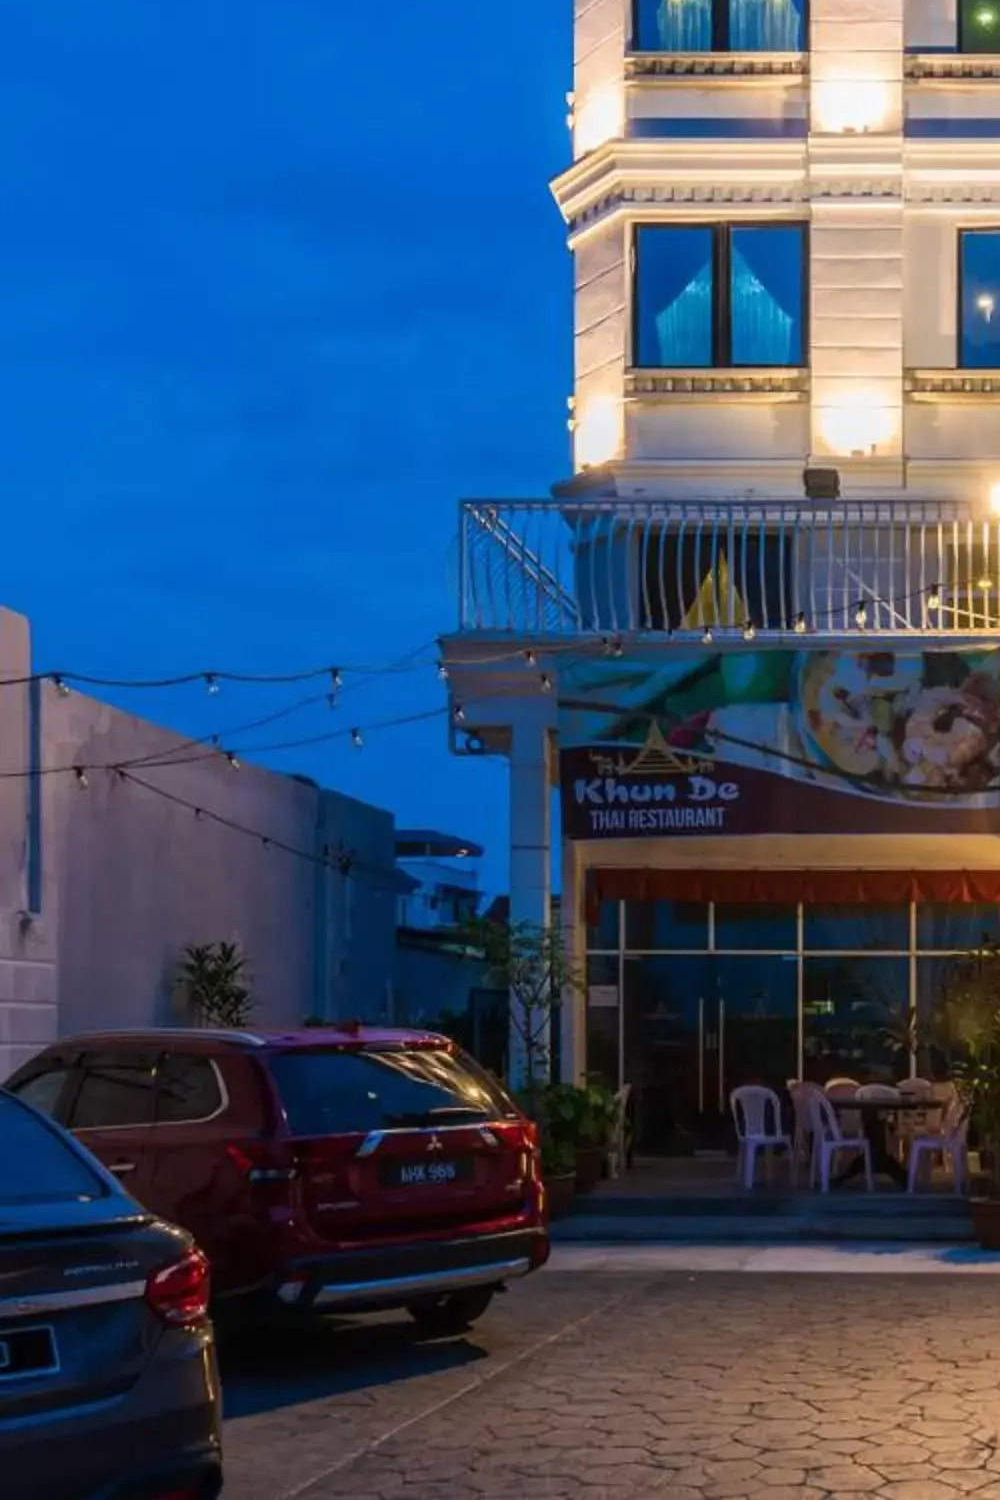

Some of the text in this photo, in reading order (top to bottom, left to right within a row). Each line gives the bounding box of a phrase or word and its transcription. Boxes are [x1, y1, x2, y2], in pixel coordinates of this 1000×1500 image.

[574, 776, 740, 804] Khun De
[591, 807, 727, 830] THAI RESTAURANT
